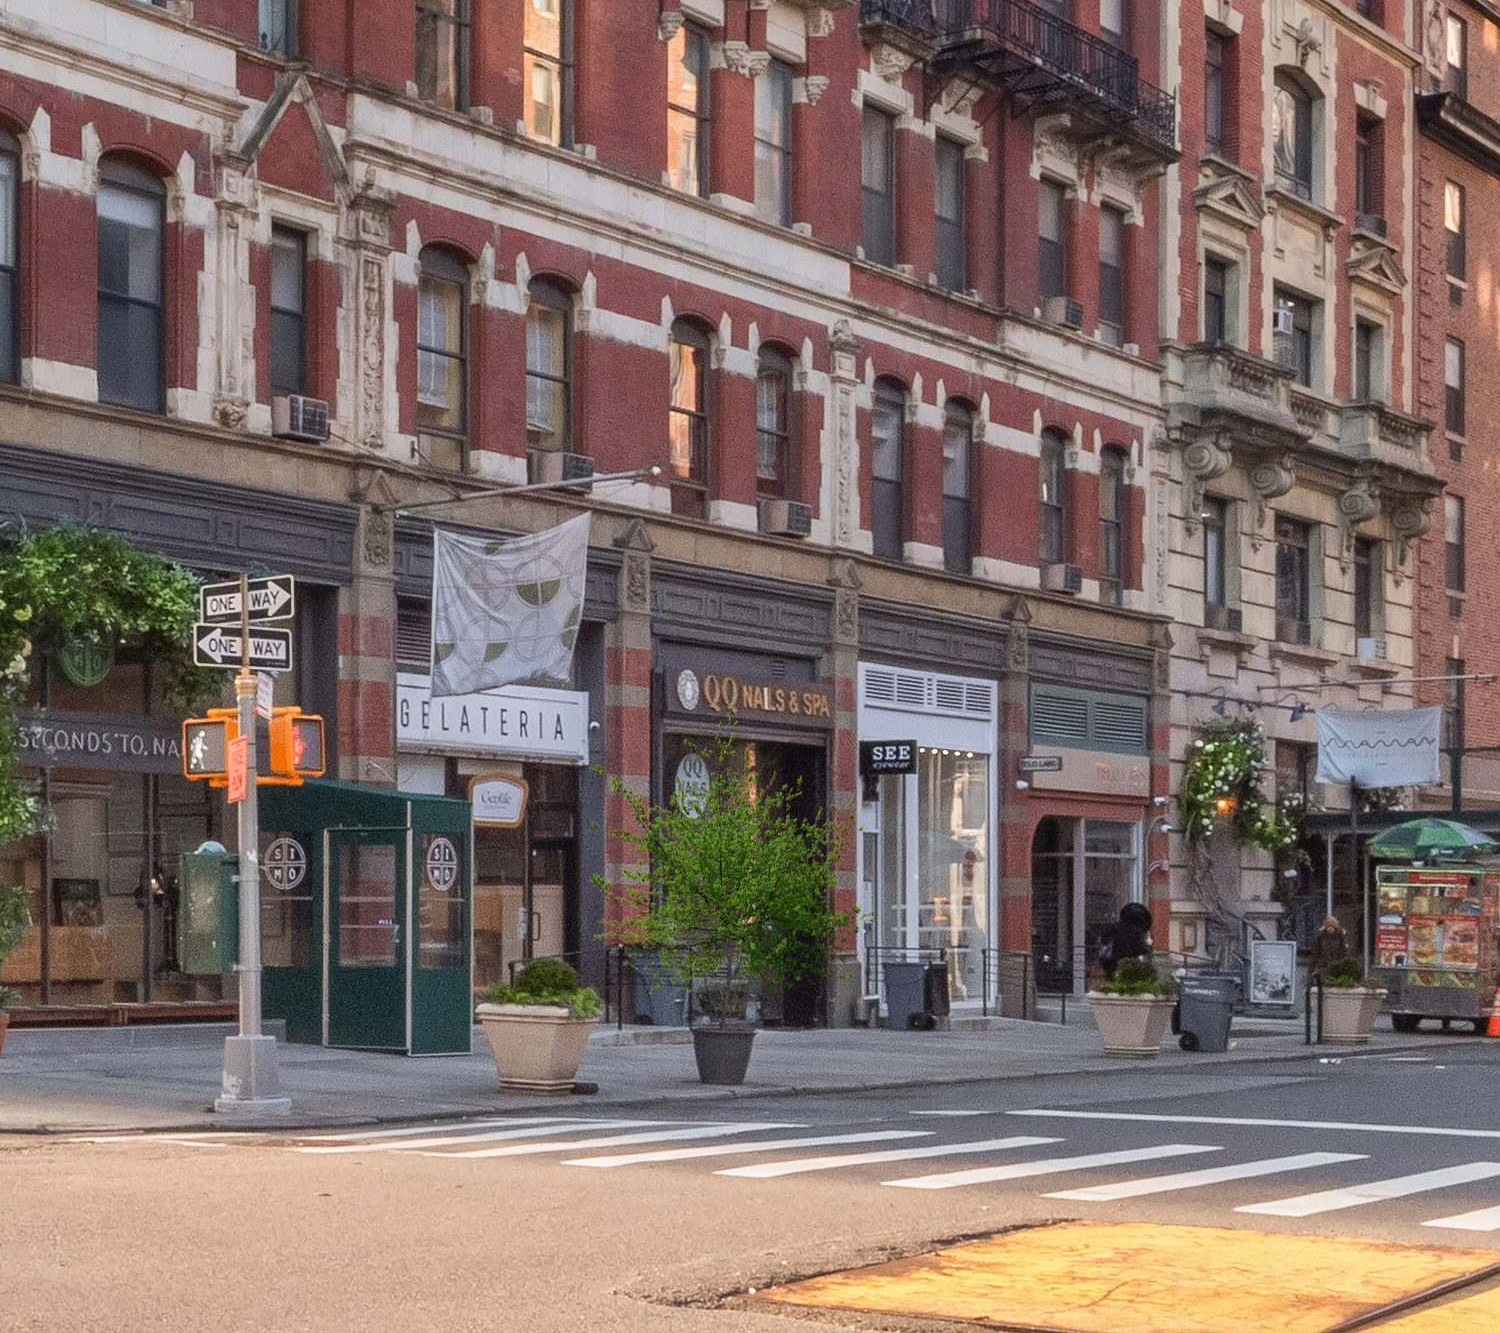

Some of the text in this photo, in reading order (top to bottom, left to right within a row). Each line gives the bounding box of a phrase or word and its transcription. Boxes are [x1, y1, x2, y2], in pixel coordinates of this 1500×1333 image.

[210, 591, 280, 612] ONE WAY
[208, 638, 282, 658] ONE WAY
[704, 674, 831, 717] QQ NAILS & SPA
[400, 698, 564, 740] GELATERIA
[873, 745, 911, 760] SEE
